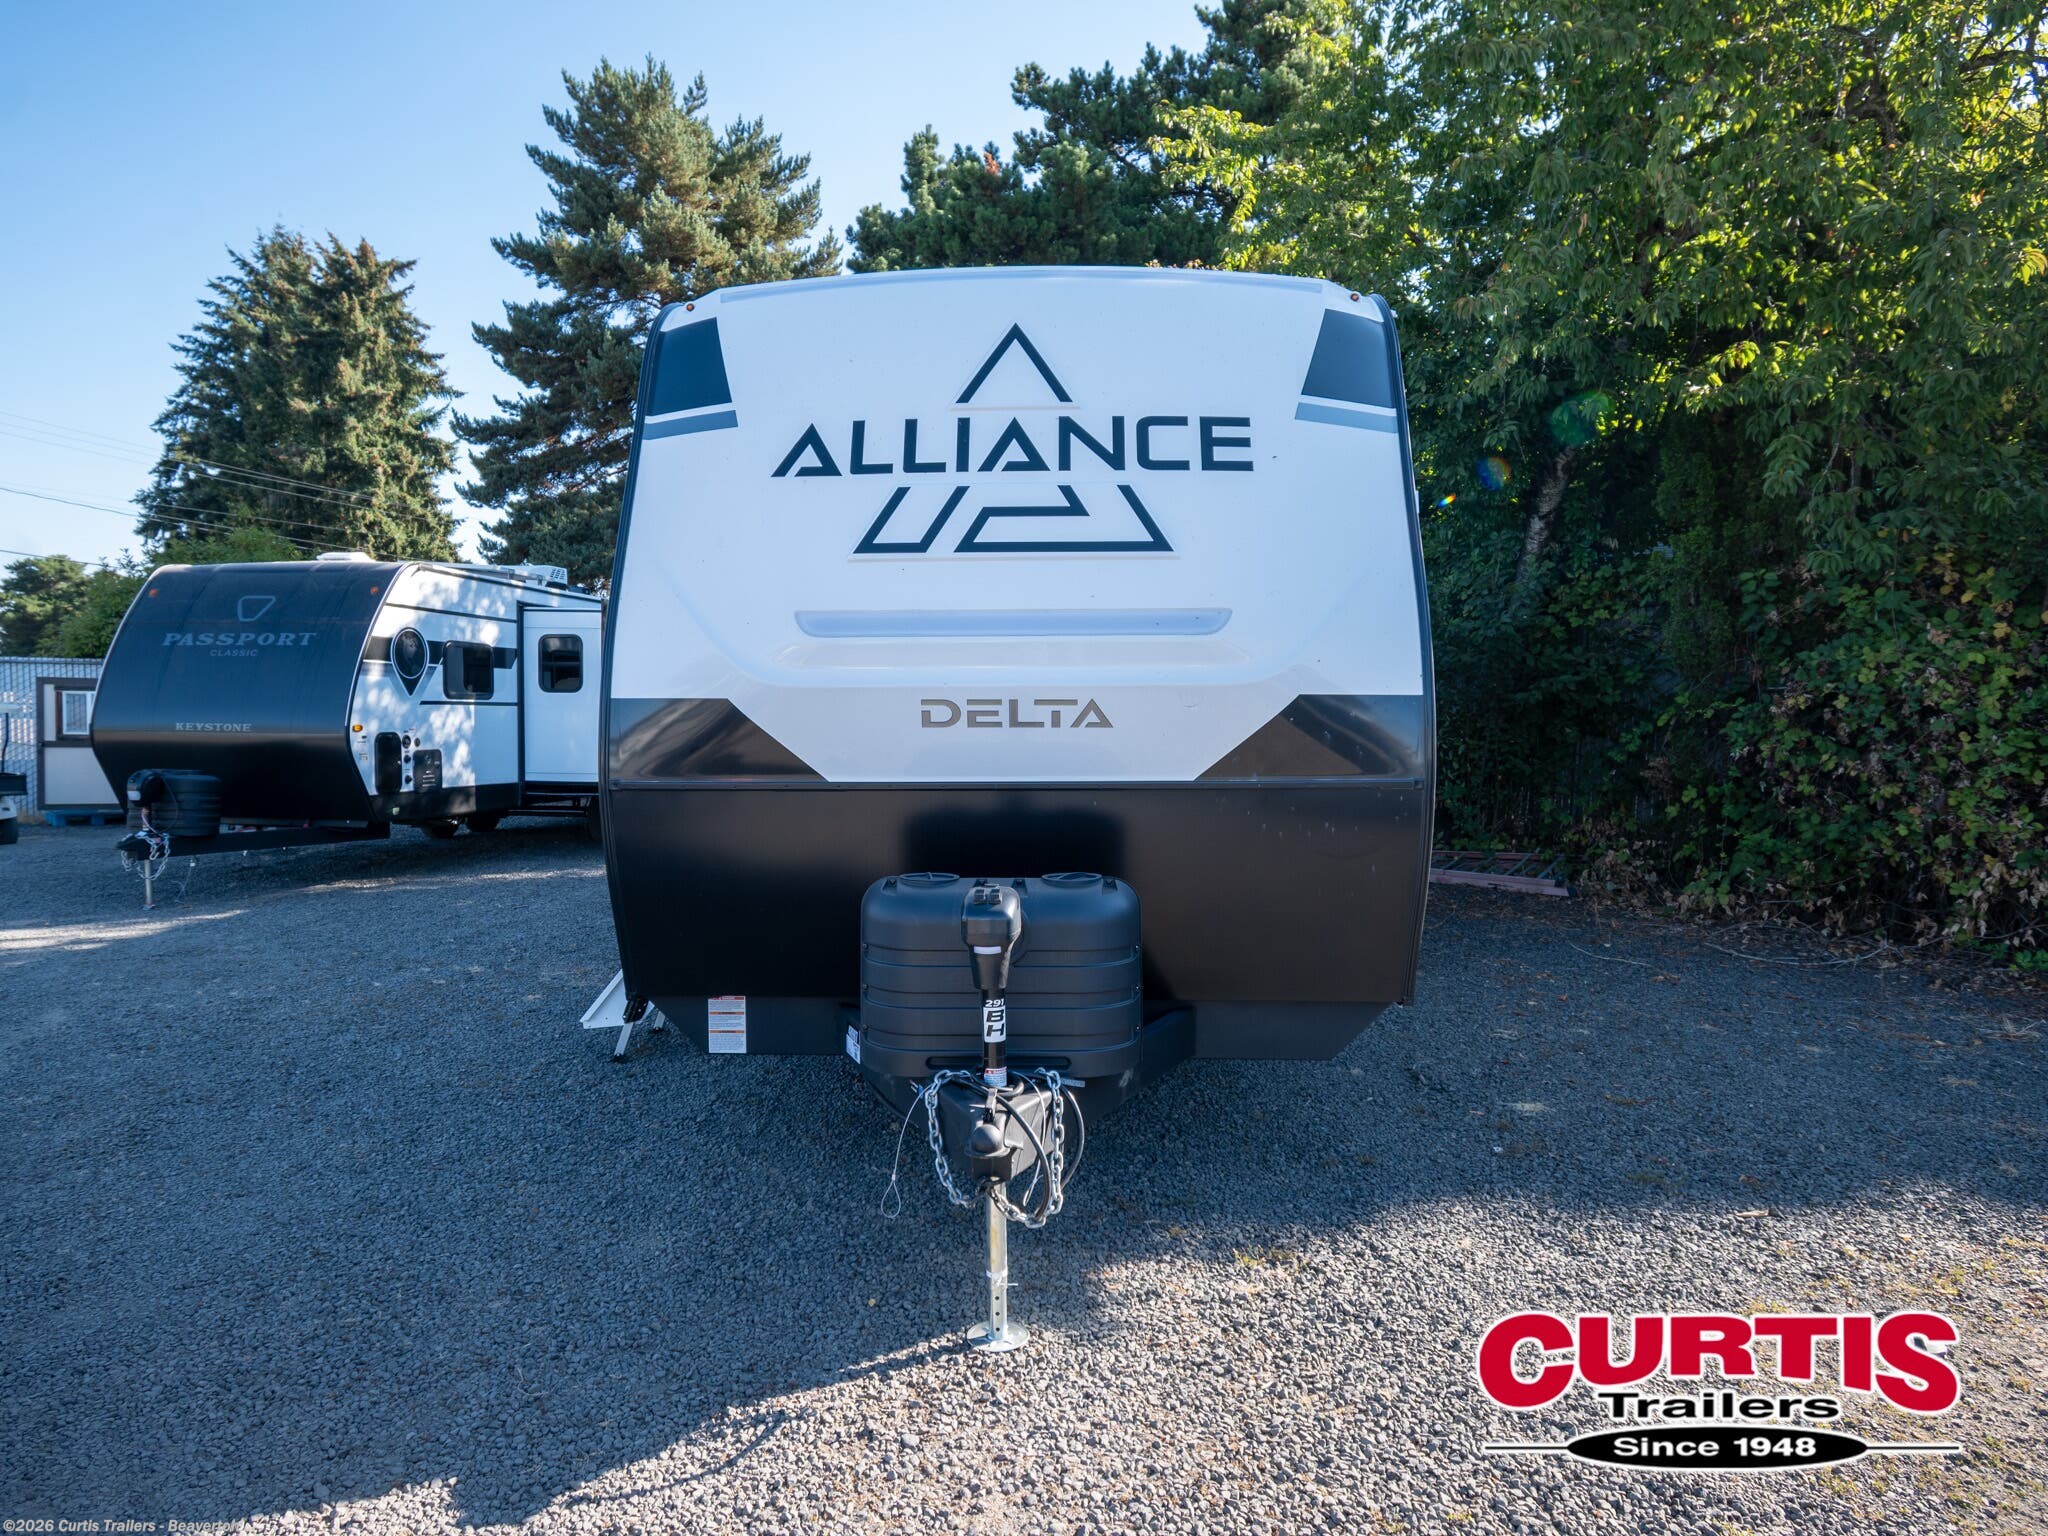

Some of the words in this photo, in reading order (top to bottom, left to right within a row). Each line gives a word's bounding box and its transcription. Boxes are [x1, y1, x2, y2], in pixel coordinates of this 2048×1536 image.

[771, 415, 1255, 478] ALLIANCE
[162, 632, 317, 646] PASSPORT
[210, 649, 258, 657] CLASSIC
[920, 698, 1114, 729] DELTA
[175, 723, 252, 732] KEYSTONE
